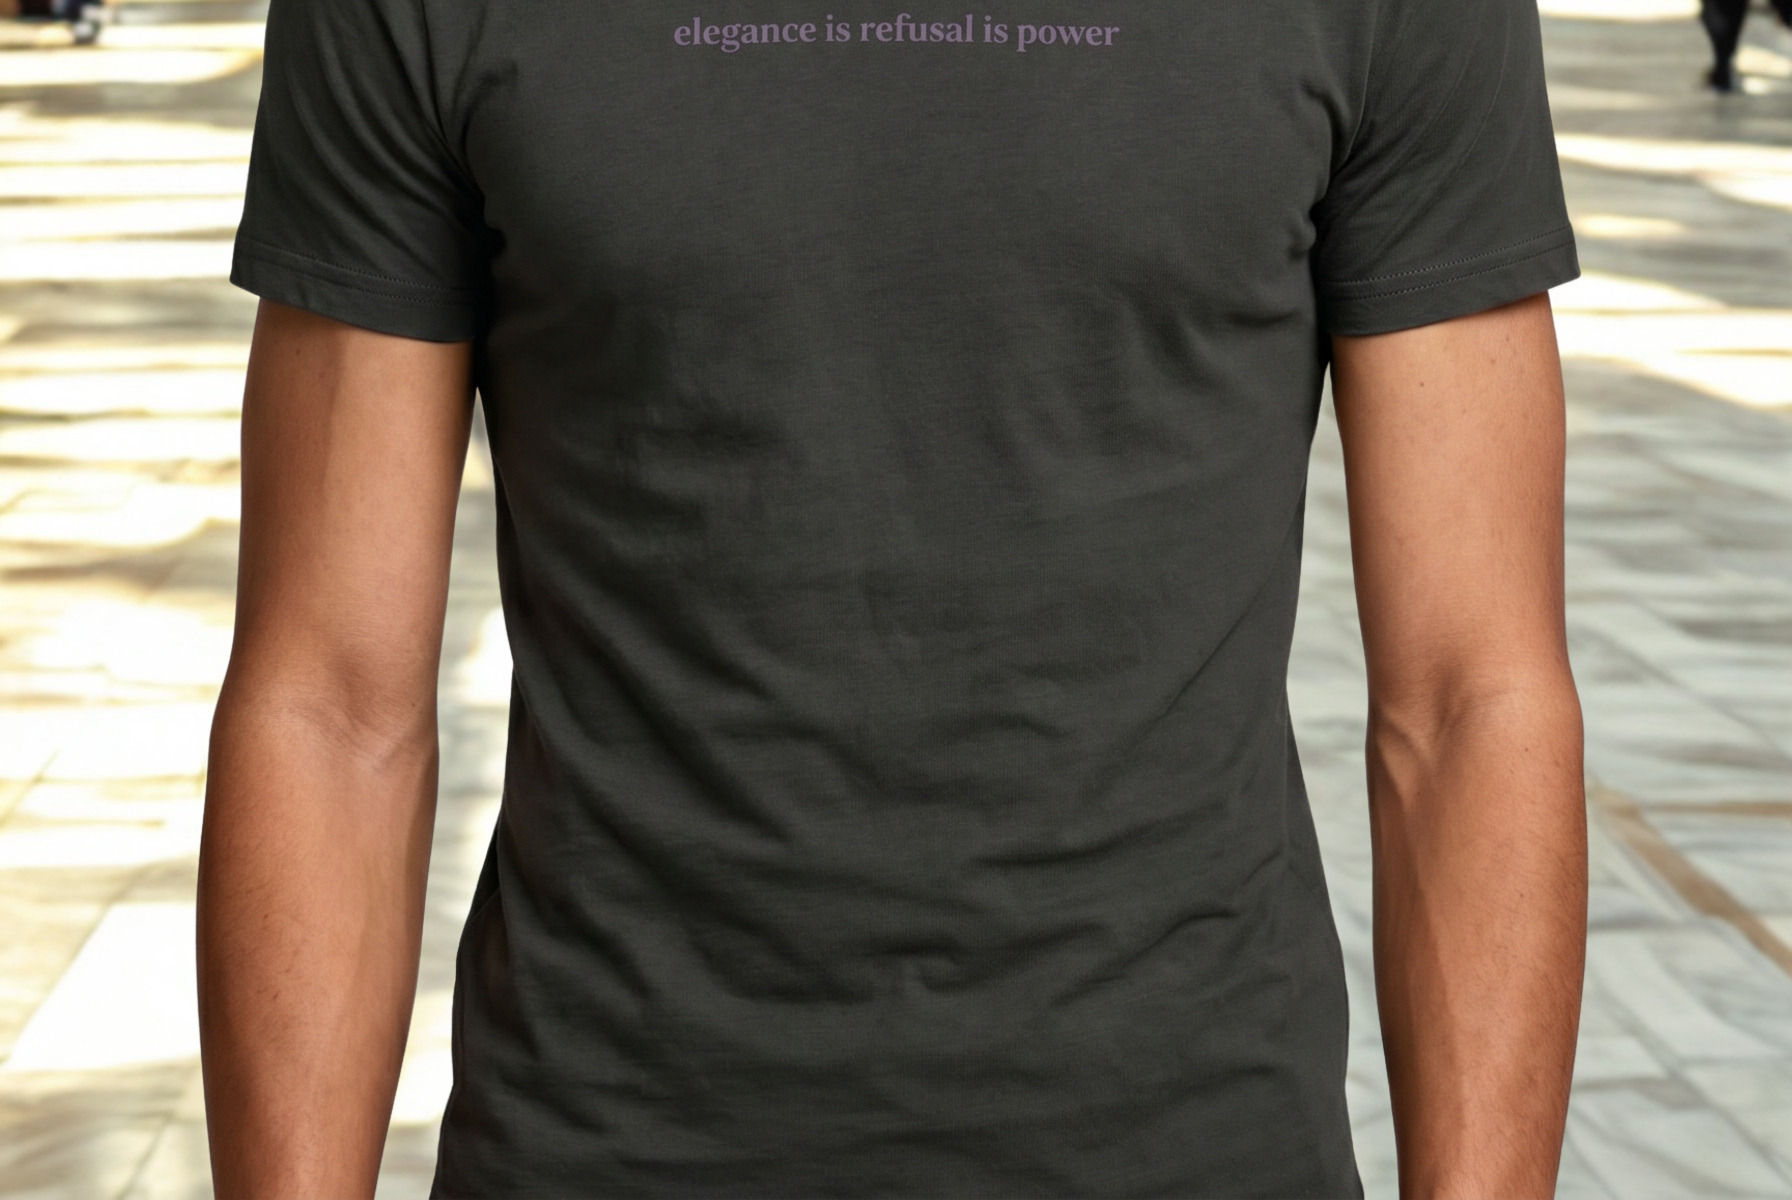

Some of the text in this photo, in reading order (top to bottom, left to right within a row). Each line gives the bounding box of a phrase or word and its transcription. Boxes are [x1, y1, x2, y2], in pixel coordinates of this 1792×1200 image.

[674, 13, 1120, 53] elegance is refusal is power
